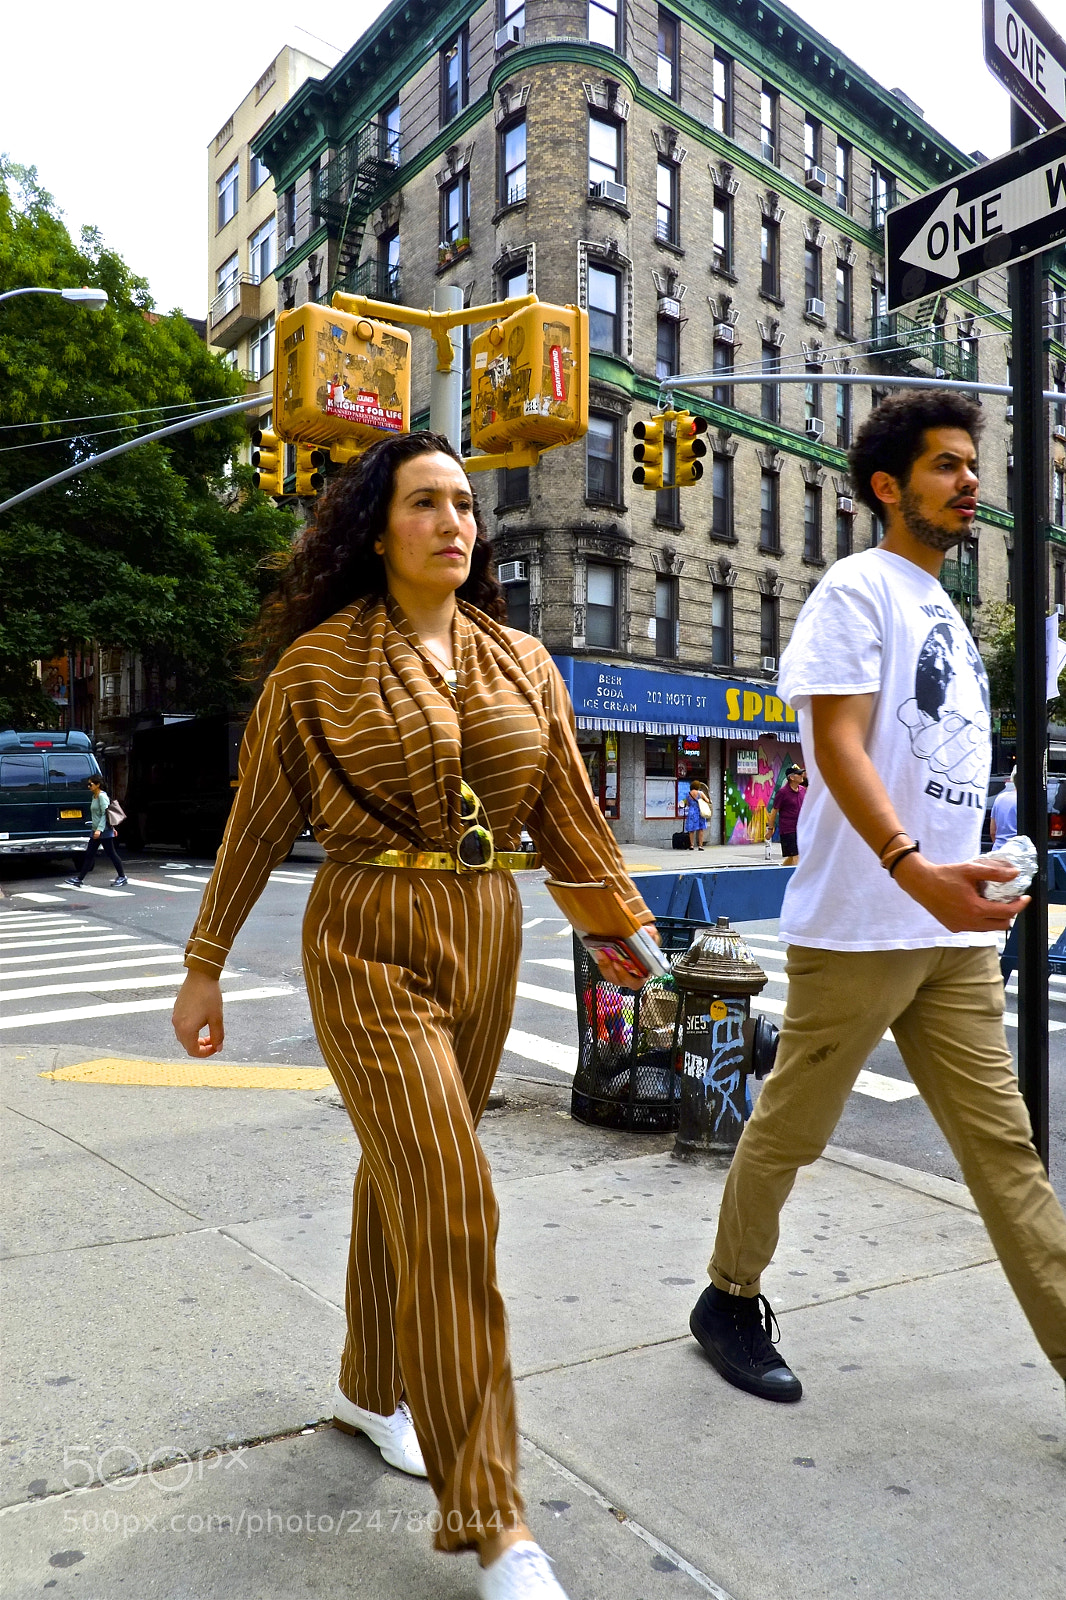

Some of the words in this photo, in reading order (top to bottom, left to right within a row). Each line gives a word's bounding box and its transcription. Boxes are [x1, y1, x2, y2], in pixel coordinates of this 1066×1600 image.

[1006, 13, 1046, 94] ONE
[927, 192, 1003, 261] ONE
[327, 399, 364, 414] KIGHTS
[366, 406, 384, 417] FOR
[385, 410, 402, 420] LIFE
[598, 674, 622, 686] BEER
[597, 686, 624, 699] SODA
[646, 690, 662, 704] 202
[666, 693, 693, 707] MOTT
[696, 696, 707, 708] ST
[583, 699, 599, 709] ICE
[603, 700, 637, 712] CREAM
